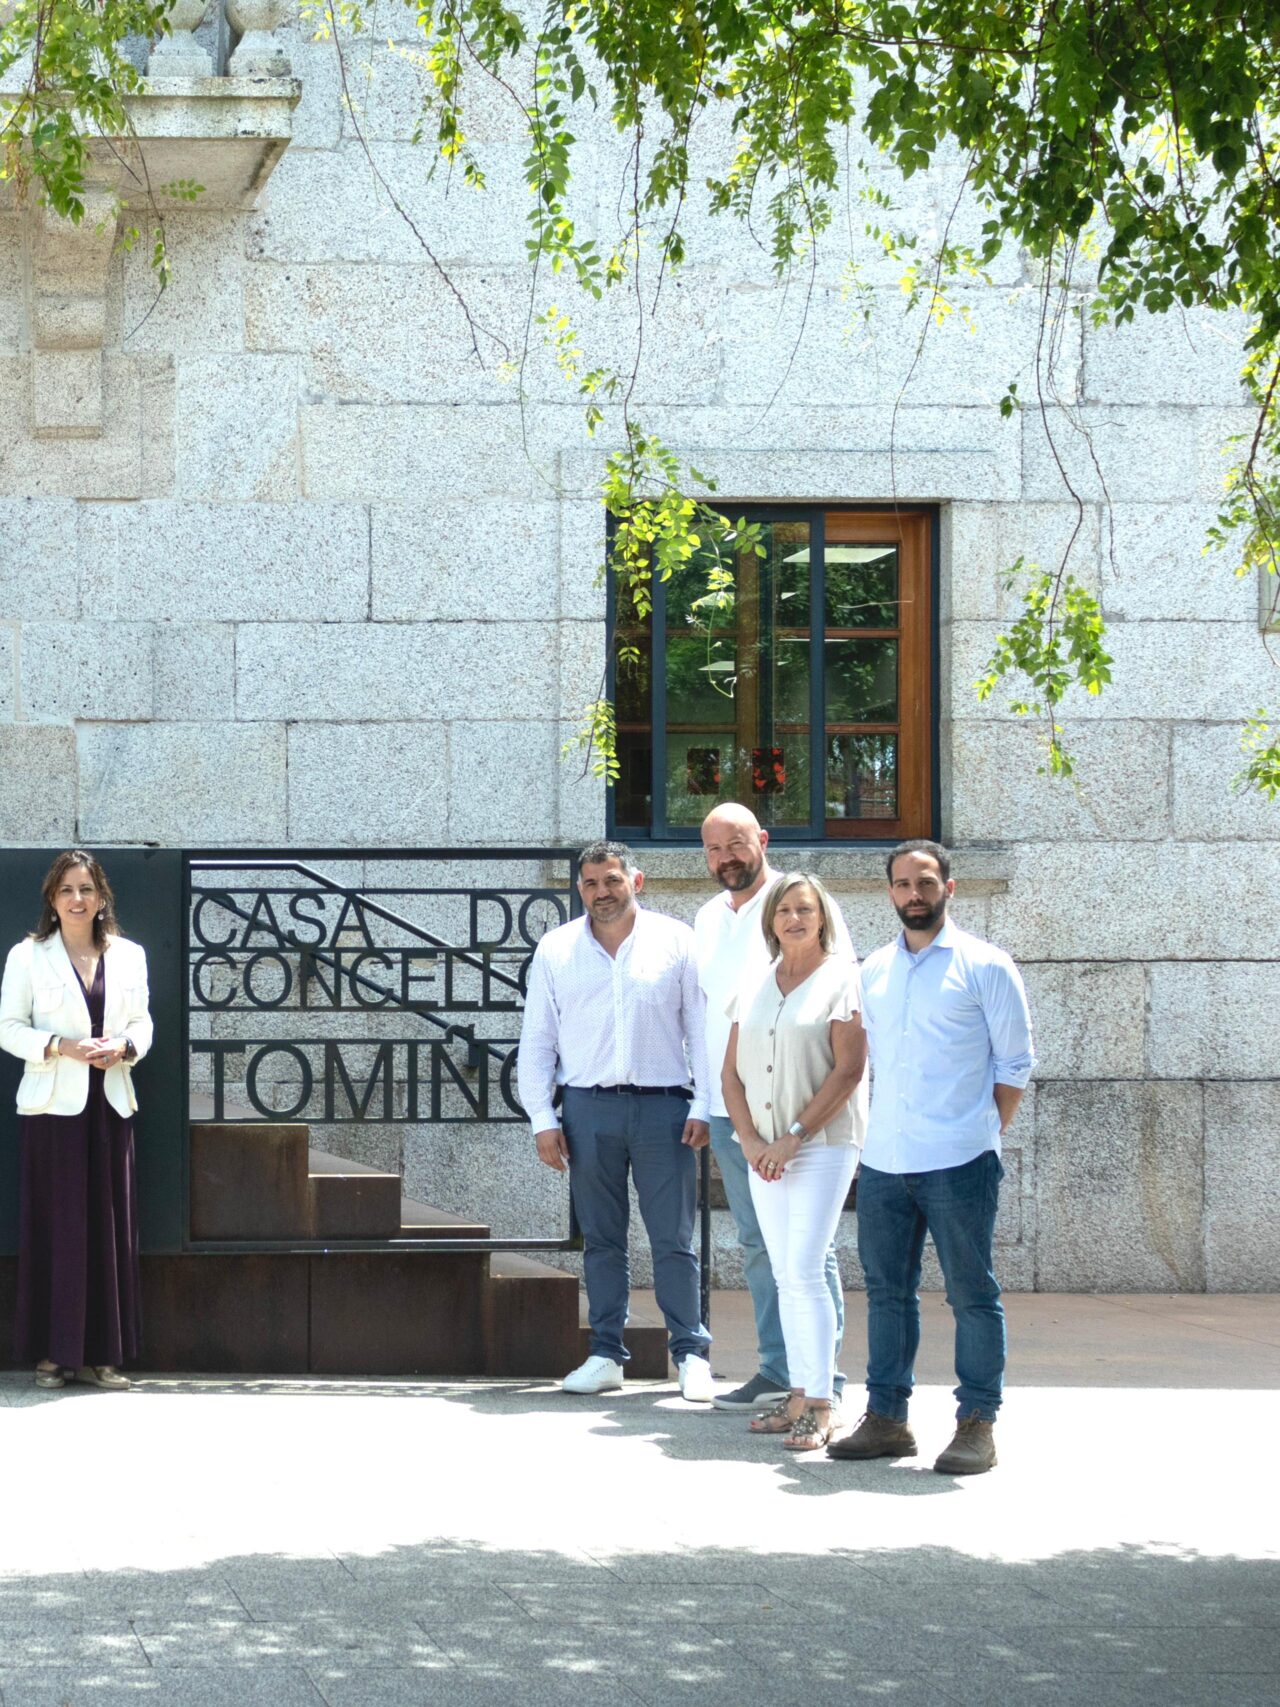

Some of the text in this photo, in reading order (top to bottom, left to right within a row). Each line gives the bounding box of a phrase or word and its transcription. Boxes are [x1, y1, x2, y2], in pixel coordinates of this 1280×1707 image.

[192, 889, 568, 950] CASA DO
[192, 950, 533, 1010] CONCELL
